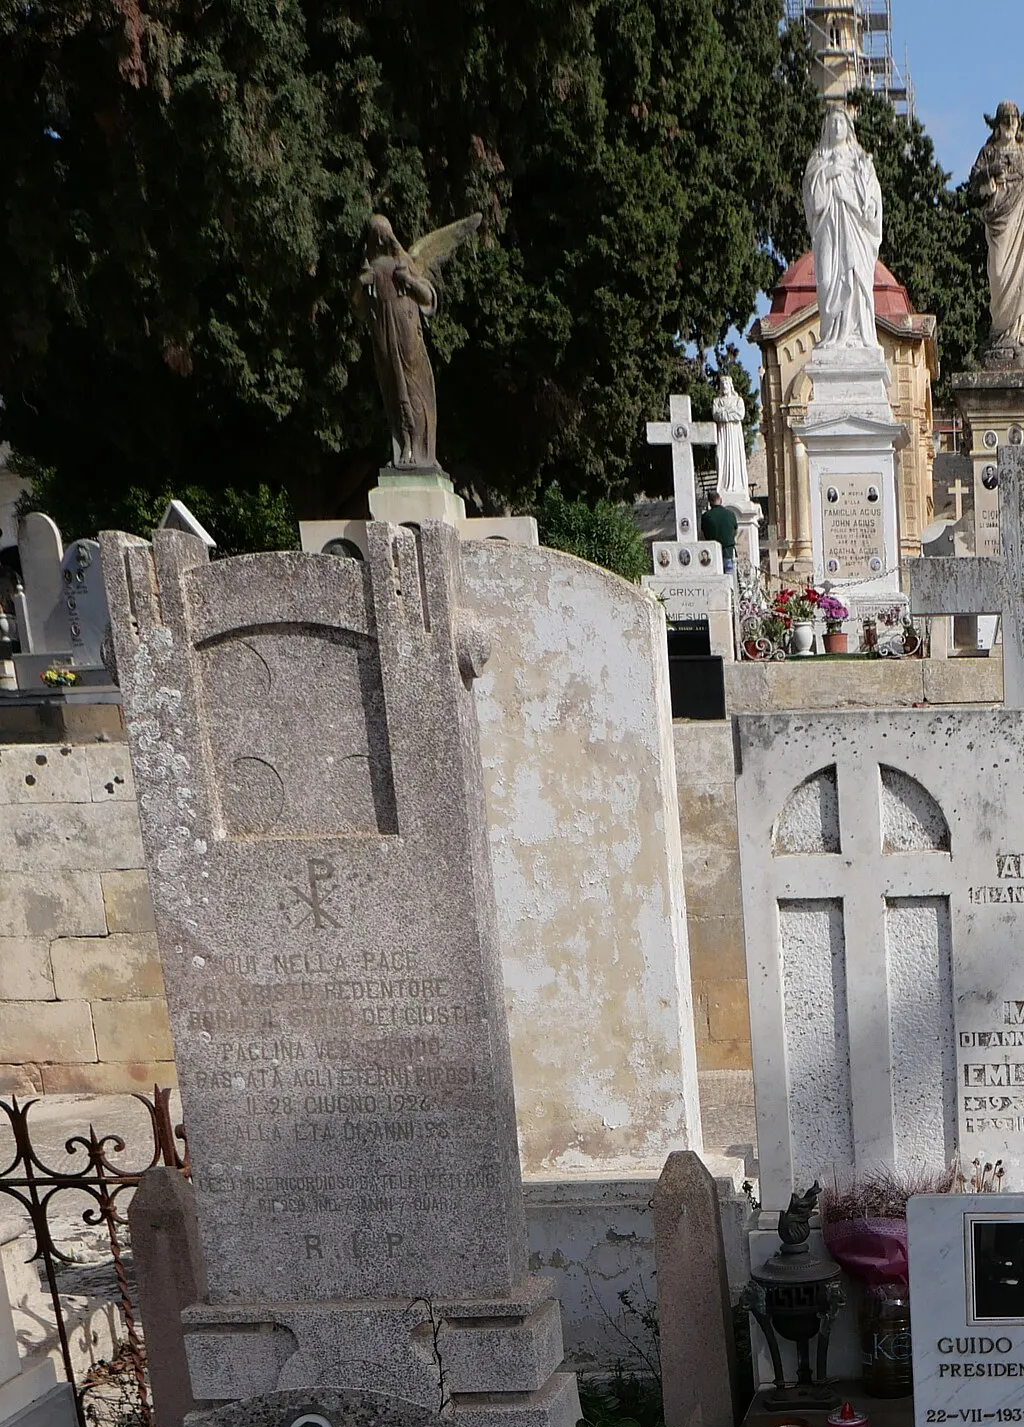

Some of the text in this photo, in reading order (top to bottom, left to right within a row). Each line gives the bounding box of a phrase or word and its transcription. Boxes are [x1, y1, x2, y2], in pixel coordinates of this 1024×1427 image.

[669, 588, 705, 597] GRIXTI
[275, 953, 346, 975] NELLA
[363, 952, 418, 972] PACE
[325, 980, 450, 1000] REDENTORE
[304, 1094, 376, 1114] GIUGNO
[937, 1336, 1013, 1355] GUIDO
